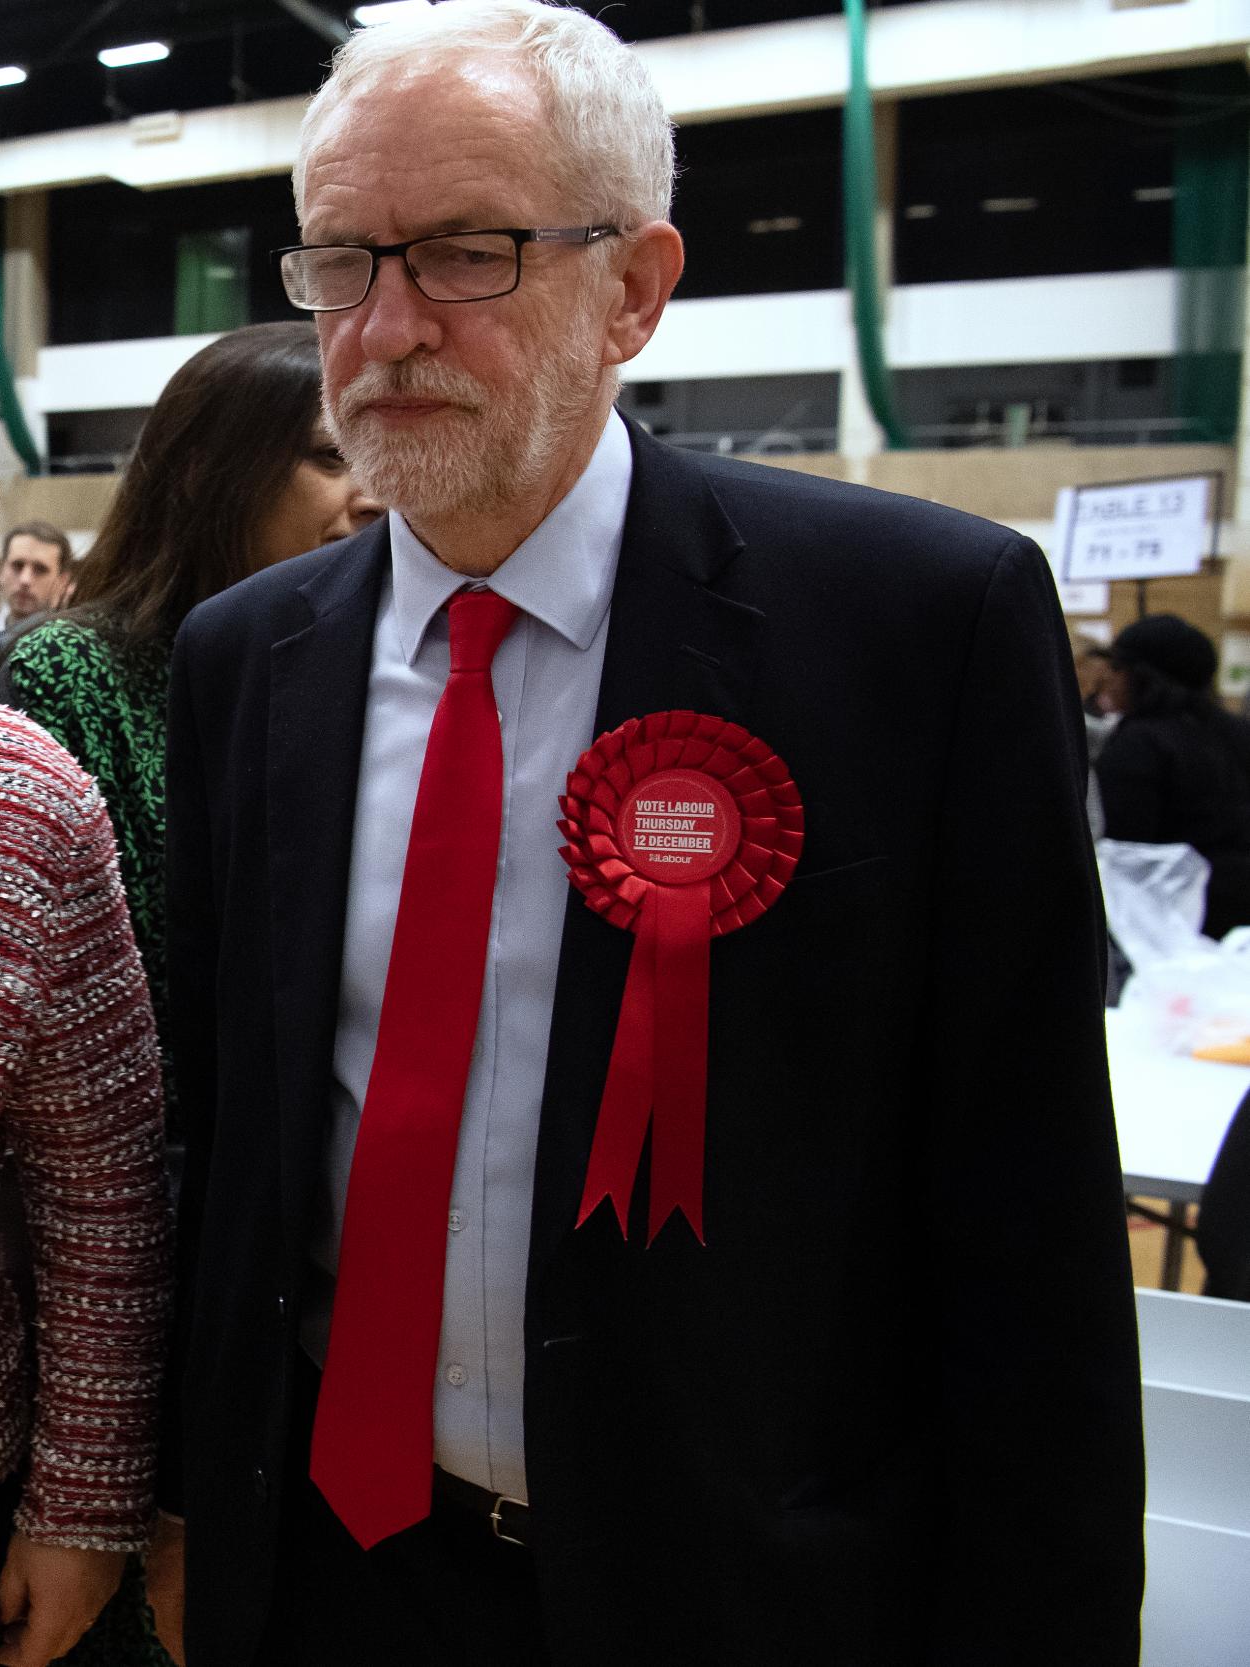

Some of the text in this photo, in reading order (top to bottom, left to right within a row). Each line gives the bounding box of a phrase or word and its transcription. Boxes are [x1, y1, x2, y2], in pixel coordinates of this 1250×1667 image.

[636, 800, 715, 814] VOTE LABOUR
[635, 818, 696, 830] THURSDAY
[634, 834, 711, 849] 12 DECEMBER
[657, 854, 692, 863] Labour
